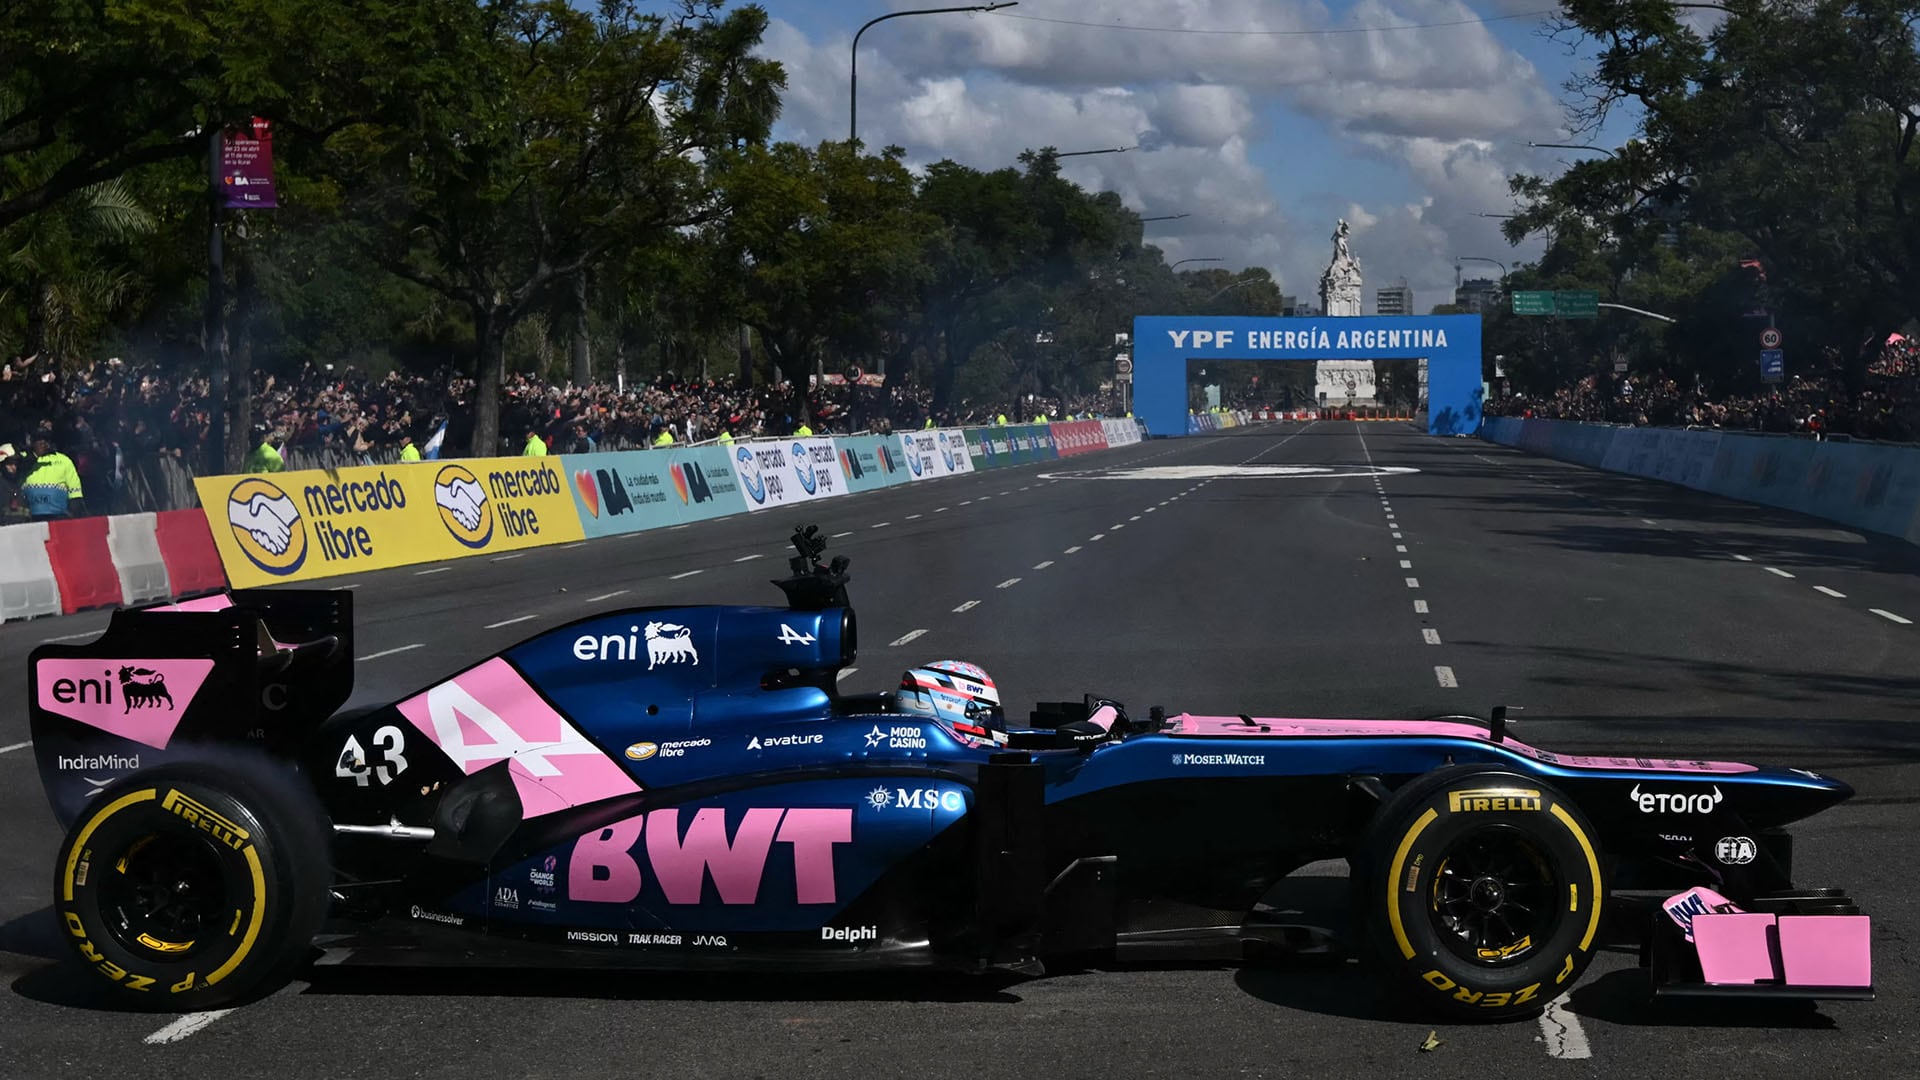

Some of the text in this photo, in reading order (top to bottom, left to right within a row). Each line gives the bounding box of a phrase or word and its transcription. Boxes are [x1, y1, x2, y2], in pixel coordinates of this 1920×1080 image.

[235, 177, 249, 185] BA
[1168, 327, 1448, 349] YPF ENERGÍA ARGENTINA
[1764, 334, 1777, 343] 60
[755, 444, 786, 470] mercado
[808, 441, 836, 463] mercado
[489, 461, 560, 499] mercado
[764, 475, 784, 500] pago
[816, 468, 832, 493] pago
[304, 472, 406, 517] mercado
[496, 500, 540, 538] libre
[314, 520, 373, 562] libre
[573, 626, 638, 660] eni
[53, 670, 111, 704] eni
[966, 684, 984, 695] BWT
[764, 733, 824, 747] avature
[889, 737, 927, 749] CASINO
[890, 727, 921, 738] MODO
[659, 747, 685, 757] libre
[660, 738, 711, 749] mercado
[58, 754, 140, 770] IndraMind
[335, 726, 408, 787] 43
[896, 789, 961, 810] MSC
[1449, 788, 1541, 812] PIRELLI
[161, 788, 250, 850] PIRELLI
[568, 808, 853, 904] BWT
[530, 871, 555, 881] CHANGE
[534, 879, 554, 887] WORLD
[495, 887, 519, 902] ADA
[420, 907, 464, 925] businessolver
[567, 931, 618, 943] MISSION
[628, 933, 682, 945] TRAK RACER
[822, 925, 877, 942] Delphi
[64, 912, 195, 993] P ZERO
[1422, 954, 1574, 1007] P ZERO
